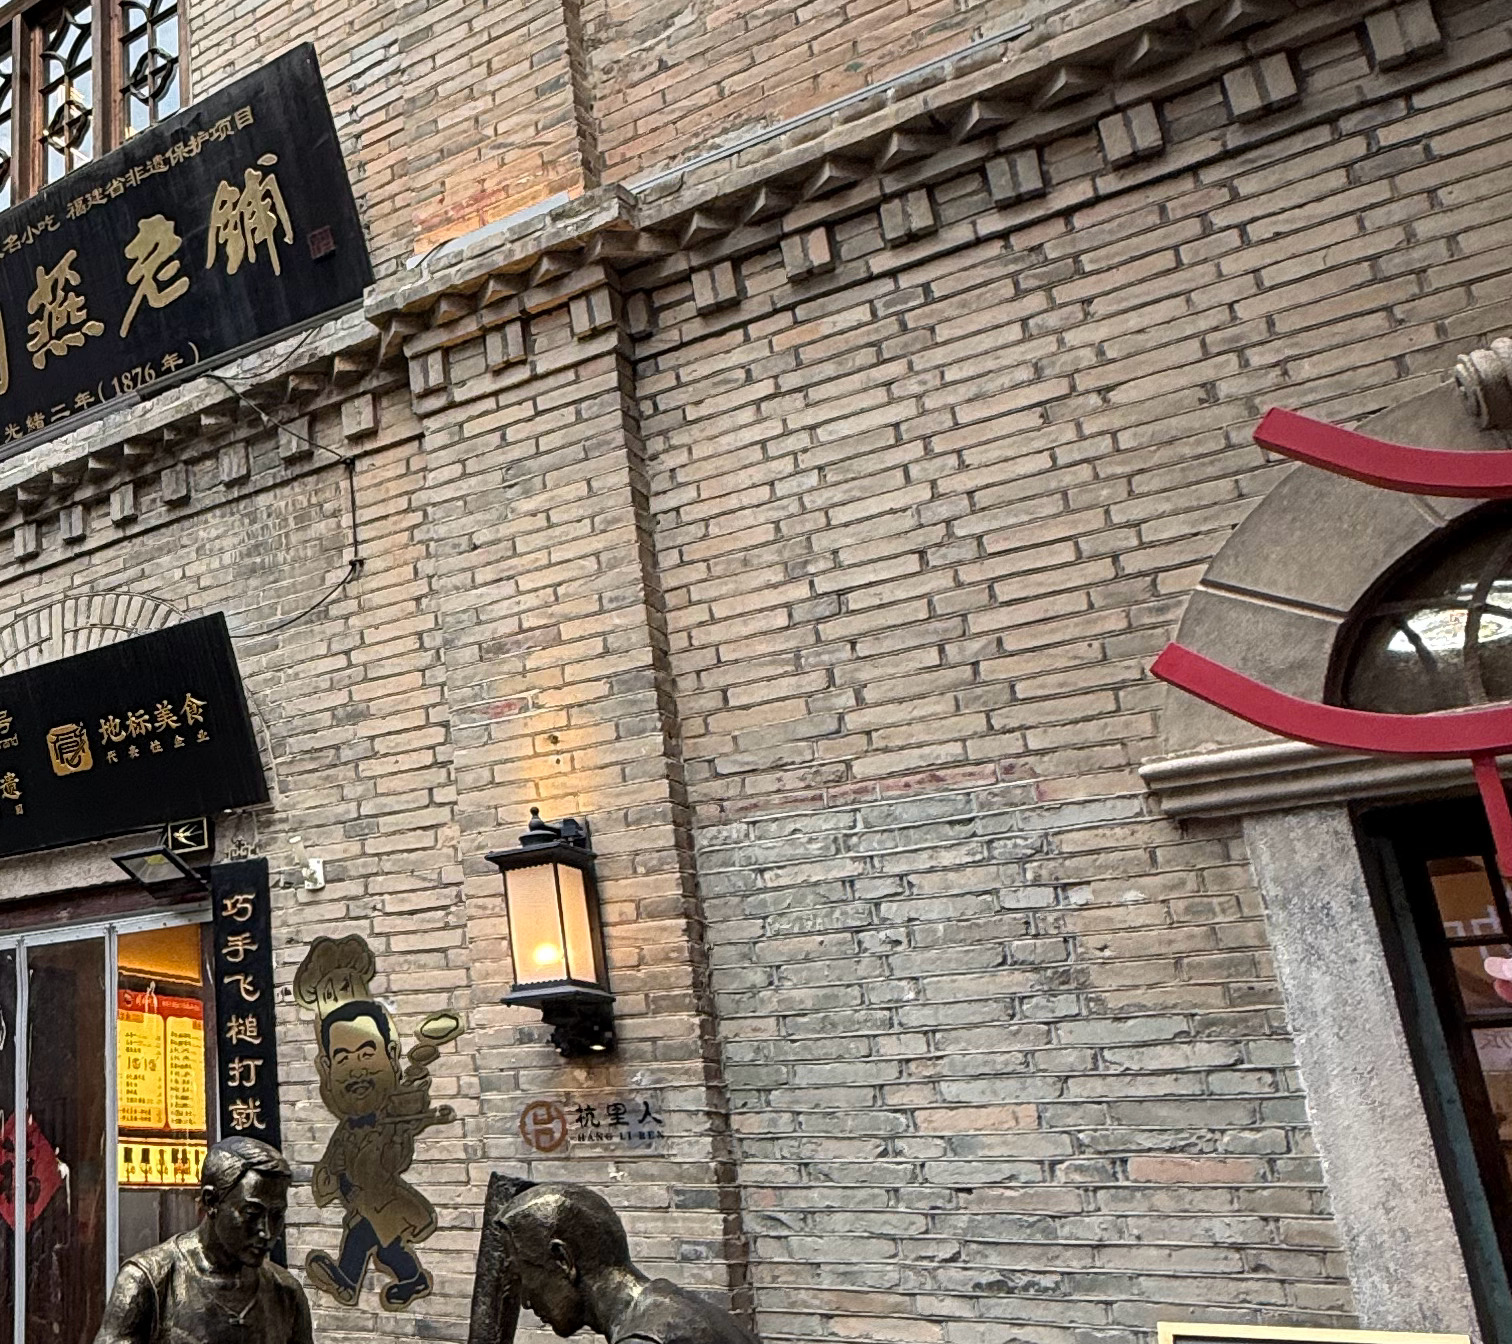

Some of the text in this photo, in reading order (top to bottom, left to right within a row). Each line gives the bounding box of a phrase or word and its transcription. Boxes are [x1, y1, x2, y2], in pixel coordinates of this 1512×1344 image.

[66, 106, 254, 220] 福建省非遗保护项目
[98, 692, 207, 745] 地标美食
[221, 892, 266, 1131] 巧手飞槌打就
[576, 1101, 663, 1128] 杭里人
[620, 1131, 632, 1141] LI
